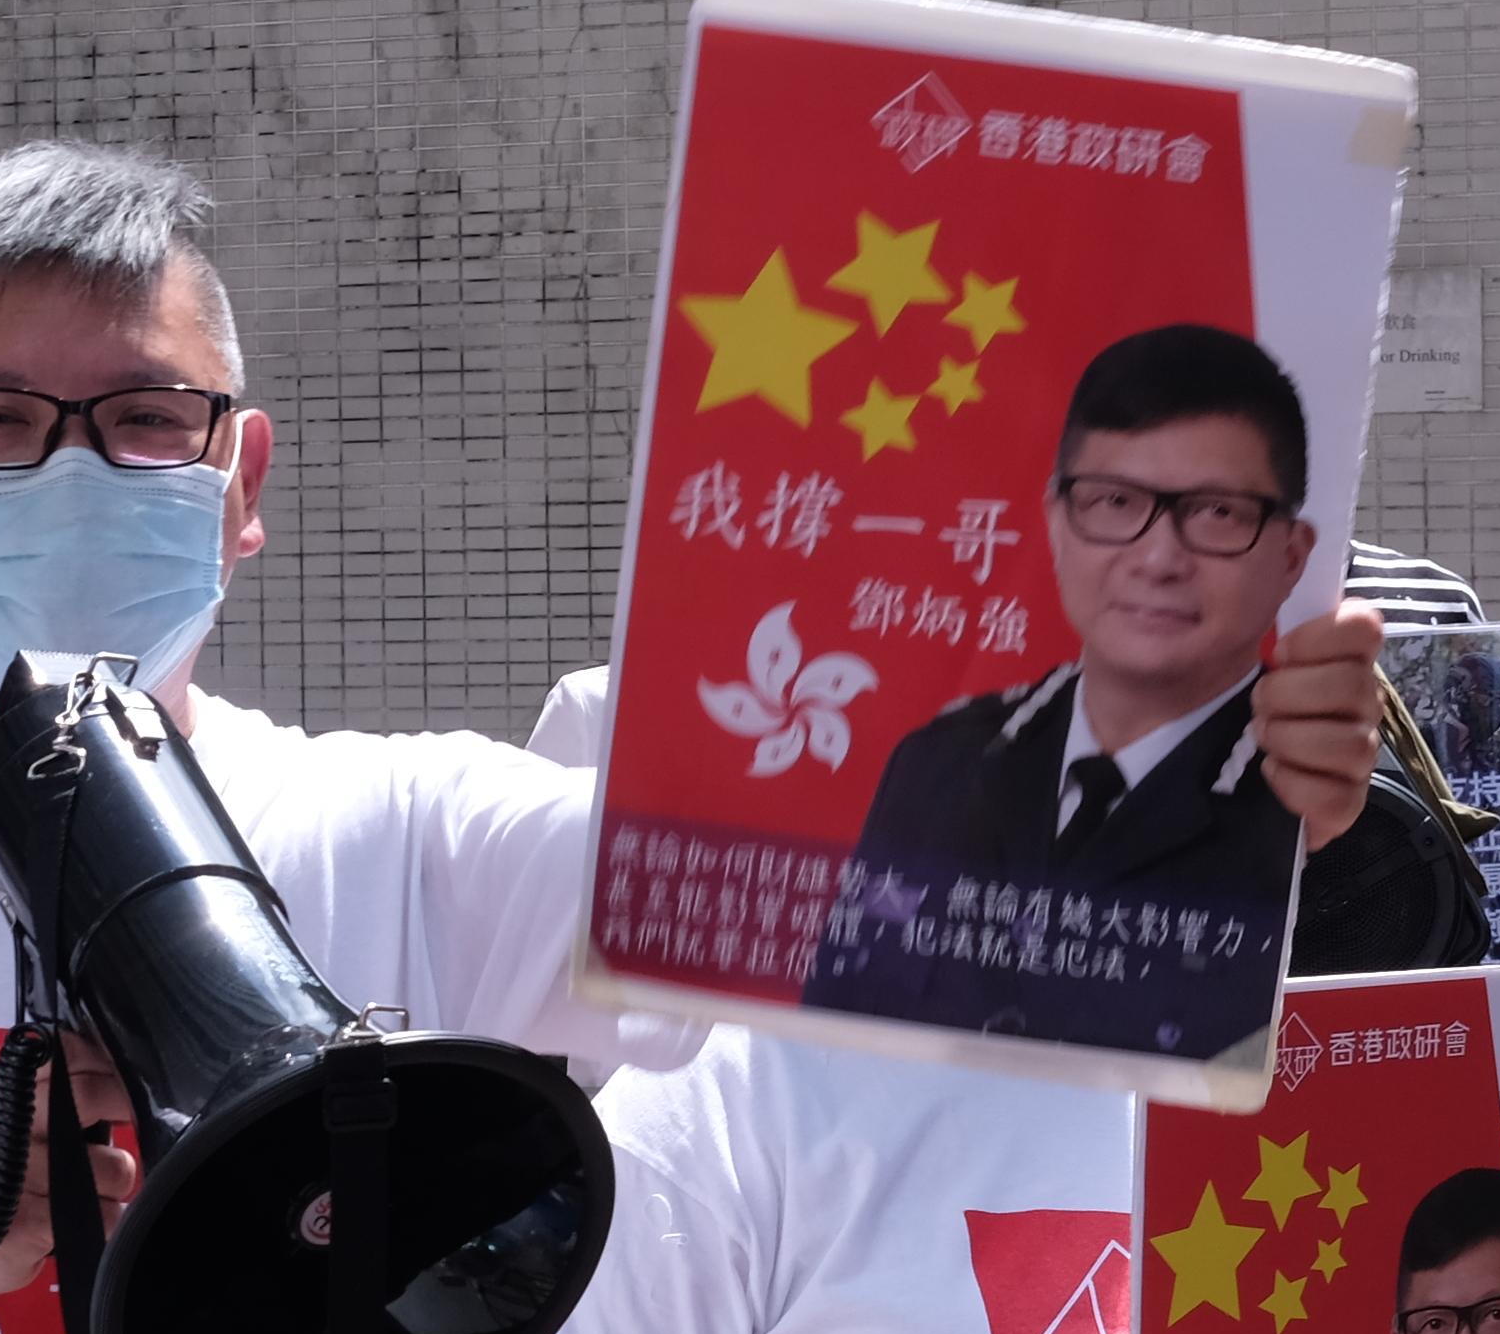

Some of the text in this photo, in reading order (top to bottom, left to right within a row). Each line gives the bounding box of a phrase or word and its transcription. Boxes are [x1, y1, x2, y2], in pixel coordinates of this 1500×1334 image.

[1400, 349, 1460, 364] Drinking
[670, 463, 1022, 587] 我撐一哥
[848, 583, 1030, 657] 鄧炳強
[1328, 1020, 1470, 1066] 香港政研會
